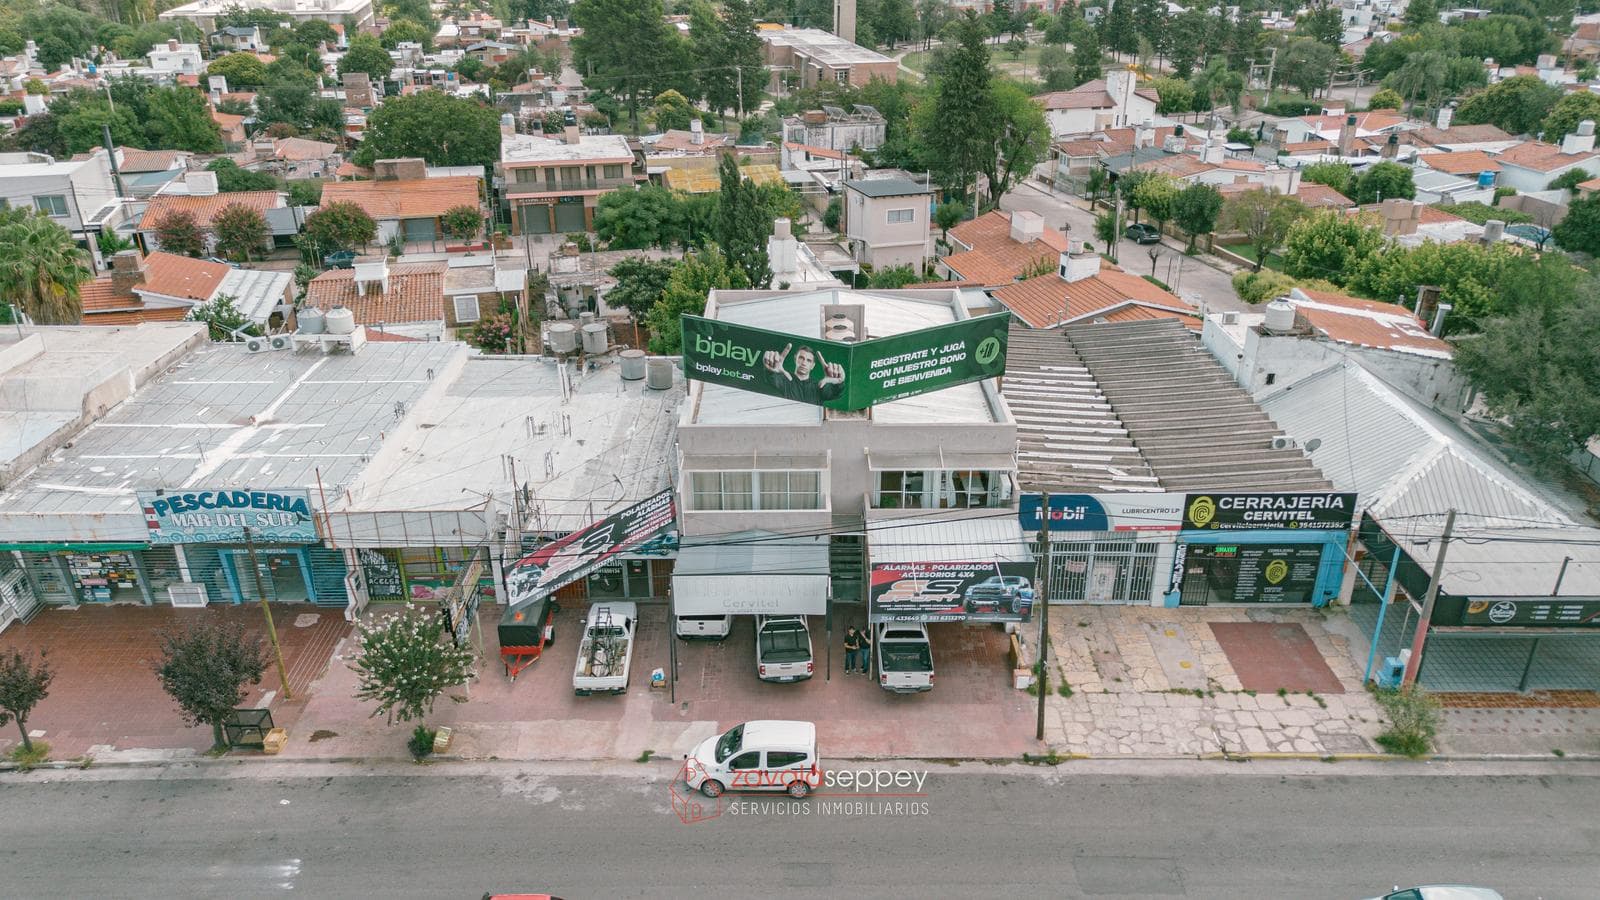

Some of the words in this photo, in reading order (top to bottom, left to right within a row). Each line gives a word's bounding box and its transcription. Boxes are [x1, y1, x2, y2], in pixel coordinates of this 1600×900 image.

[696, 333, 761, 367] bplay
[870, 349, 929, 369] REGISTRATE
[931, 347, 938, 356] Y
[696, 361, 755, 380] bplay.bet.ar
[869, 368, 892, 380] CON
[893, 358, 937, 376] NUESTRO
[940, 352, 967, 365] BONO
[883, 378, 896, 388] DE
[898, 366, 952, 387] BIENVENIDA
[151, 490, 310, 517] PESCADERIA
[620, 490, 671, 520] POLARIZADOS
[636, 496, 671, 518] ALARMAS
[1219, 494, 1344, 509] CERRAJERÍA
[170, 512, 212, 527] MAR
[215, 512, 249, 528] DEL
[256, 512, 294, 527] SUR
[1034, 506, 1085, 520] Mobil
[1243, 511, 1315, 521] CERVITEL
